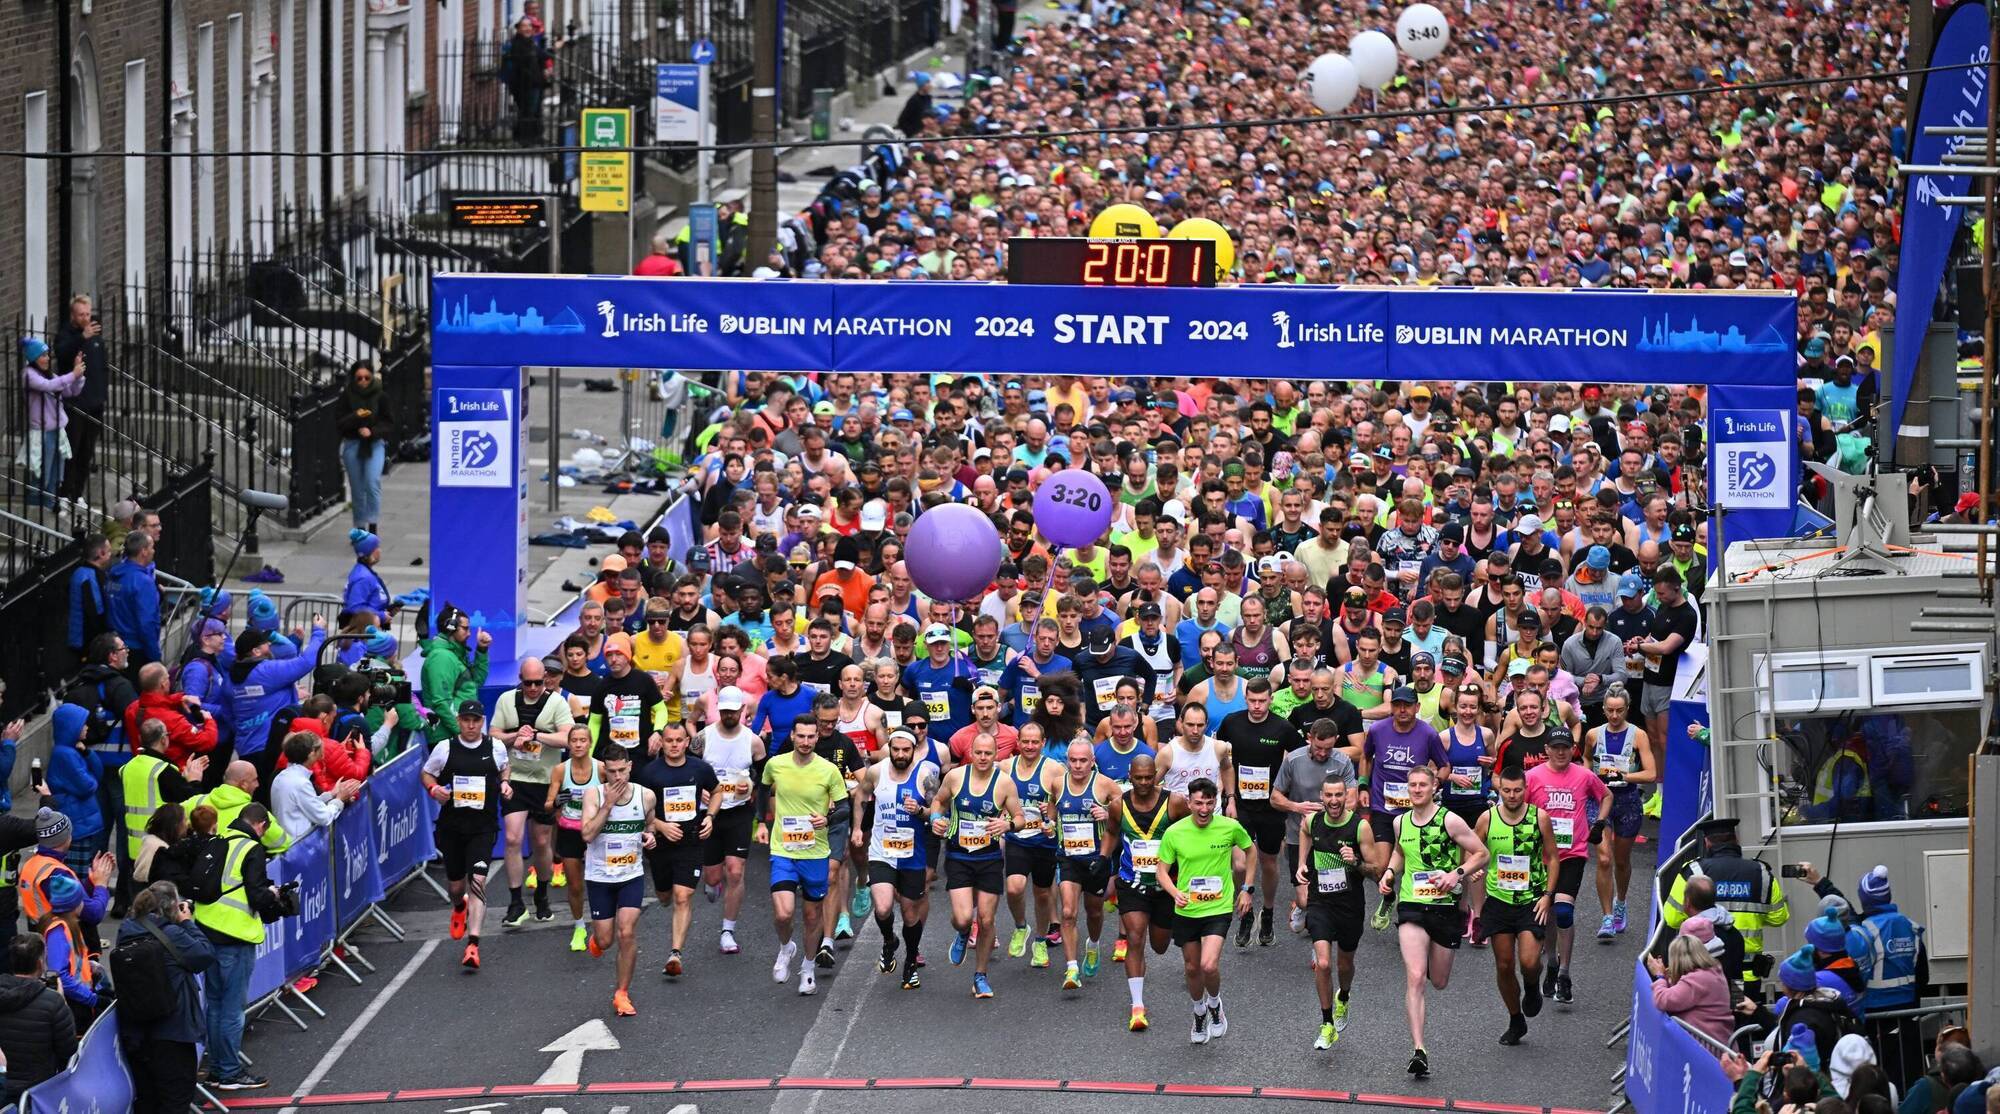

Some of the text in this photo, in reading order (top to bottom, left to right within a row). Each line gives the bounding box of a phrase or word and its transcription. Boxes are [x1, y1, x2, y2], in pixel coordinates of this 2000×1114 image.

[1408, 26, 1439, 41] 3:40
[1084, 245, 1201, 282] 20:01
[623, 314, 951, 336] Irish Life DUBLIN MARATHON
[974, 317, 1035, 336] 2024
[1053, 314, 1170, 344] START
[1188, 321, 1249, 340] 2024
[1298, 324, 1627, 346] Irish Life DUBLIN MARATHON
[460, 401, 499, 411] Irish Life
[1736, 423, 1776, 432] Irish Life
[451, 429, 460, 468] DUBLIN
[1728, 451, 1736, 490] DUBLIN
[1051, 484, 1101, 512] 3:20
[461, 793, 478, 801] 435
[1548, 792, 1573, 803] 1000
[669, 803, 691, 811] 3556
[788, 832, 809, 841] 1176
[1500, 871, 1524, 880] 3484
[1716, 882, 1750, 897] GARDA
